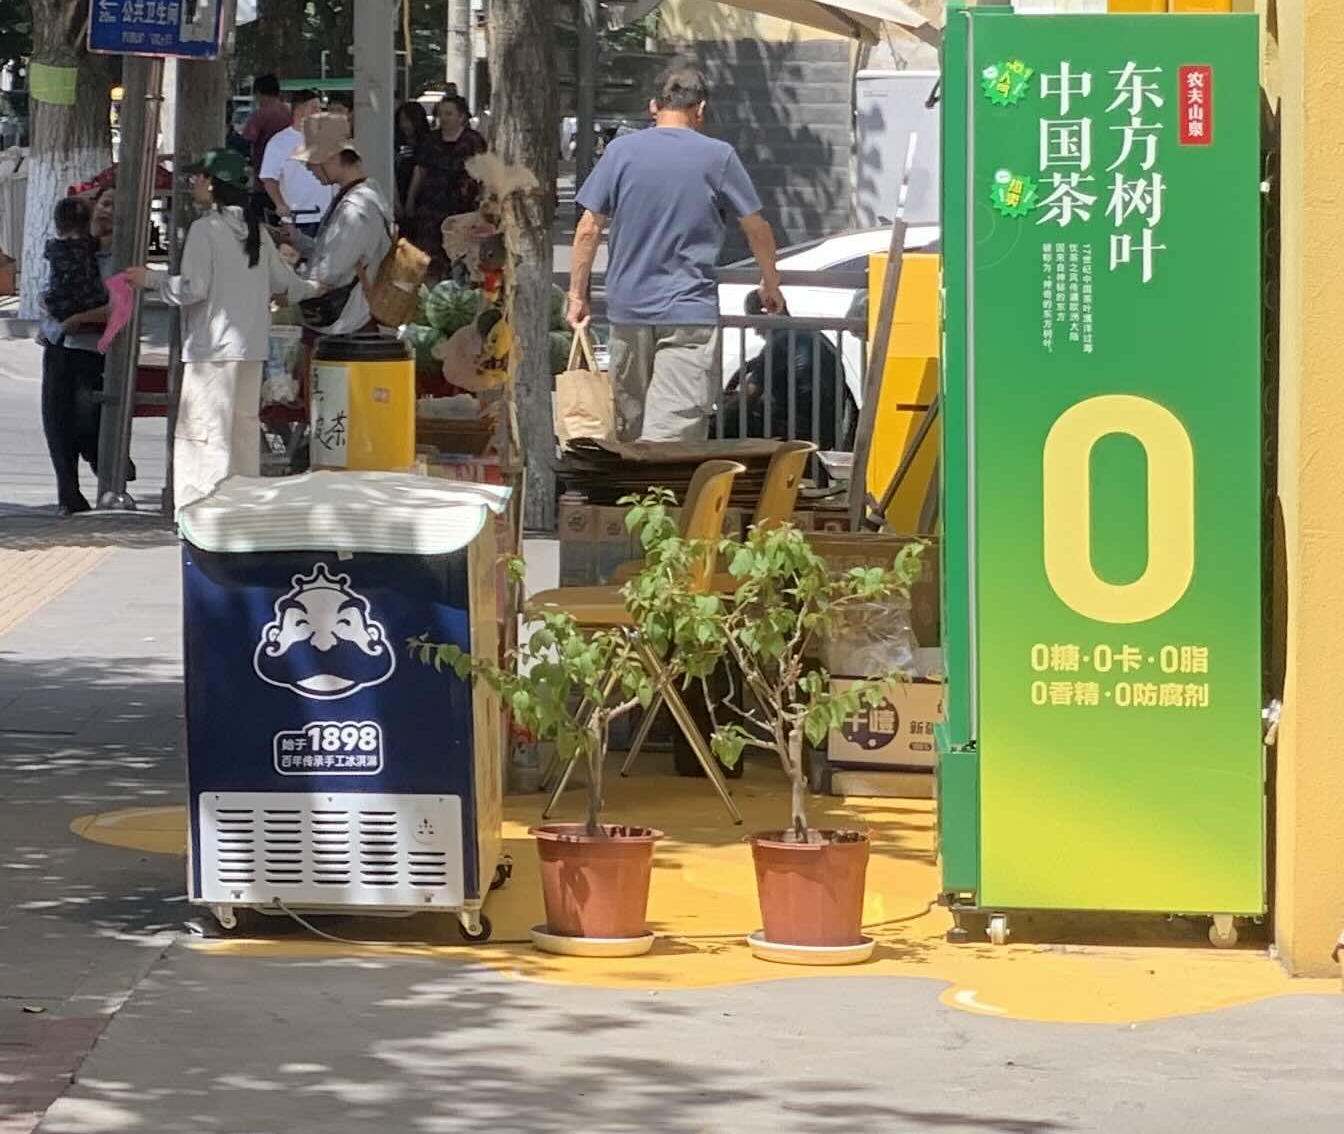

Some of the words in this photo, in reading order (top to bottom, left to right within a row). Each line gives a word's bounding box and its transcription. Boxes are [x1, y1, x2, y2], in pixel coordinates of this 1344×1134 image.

[1036, 60, 1098, 227] 中国茶
[1105, 60, 1167, 284] 东方树叶
[1185, 71, 1206, 139] 农夫山泉
[1042, 393, 1195, 625] 0
[280, 754, 378, 768] 百年传承手工冰淇淋
